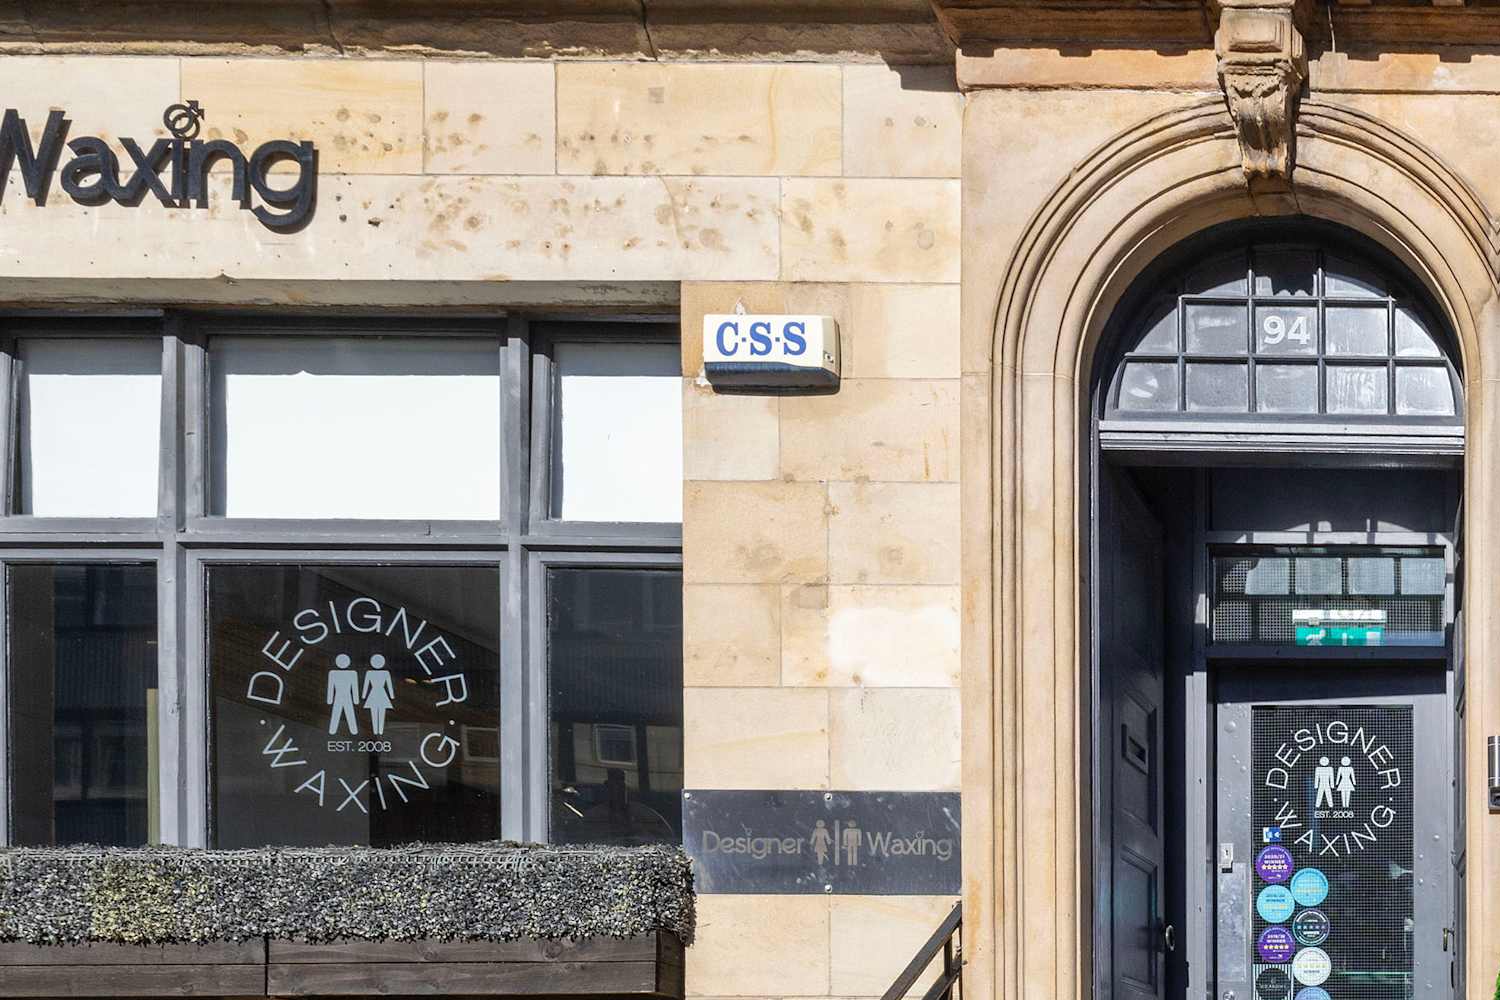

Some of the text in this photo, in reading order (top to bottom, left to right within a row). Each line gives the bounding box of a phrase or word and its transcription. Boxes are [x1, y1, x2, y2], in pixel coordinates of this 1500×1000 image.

[0, 100, 319, 233] Waxing
[1263, 315, 1310, 345] 94
[246, 597, 468, 707] DESIGNER
[261, 723, 460, 814] WAXING
[327, 740, 392, 752] EST. 2008
[1265, 720, 1401, 790] DESIGNER
[1274, 800, 1397, 857] WAXING
[1314, 810, 1355, 819] EST. 2008
[702, 828, 953, 861] Designer Waxing
